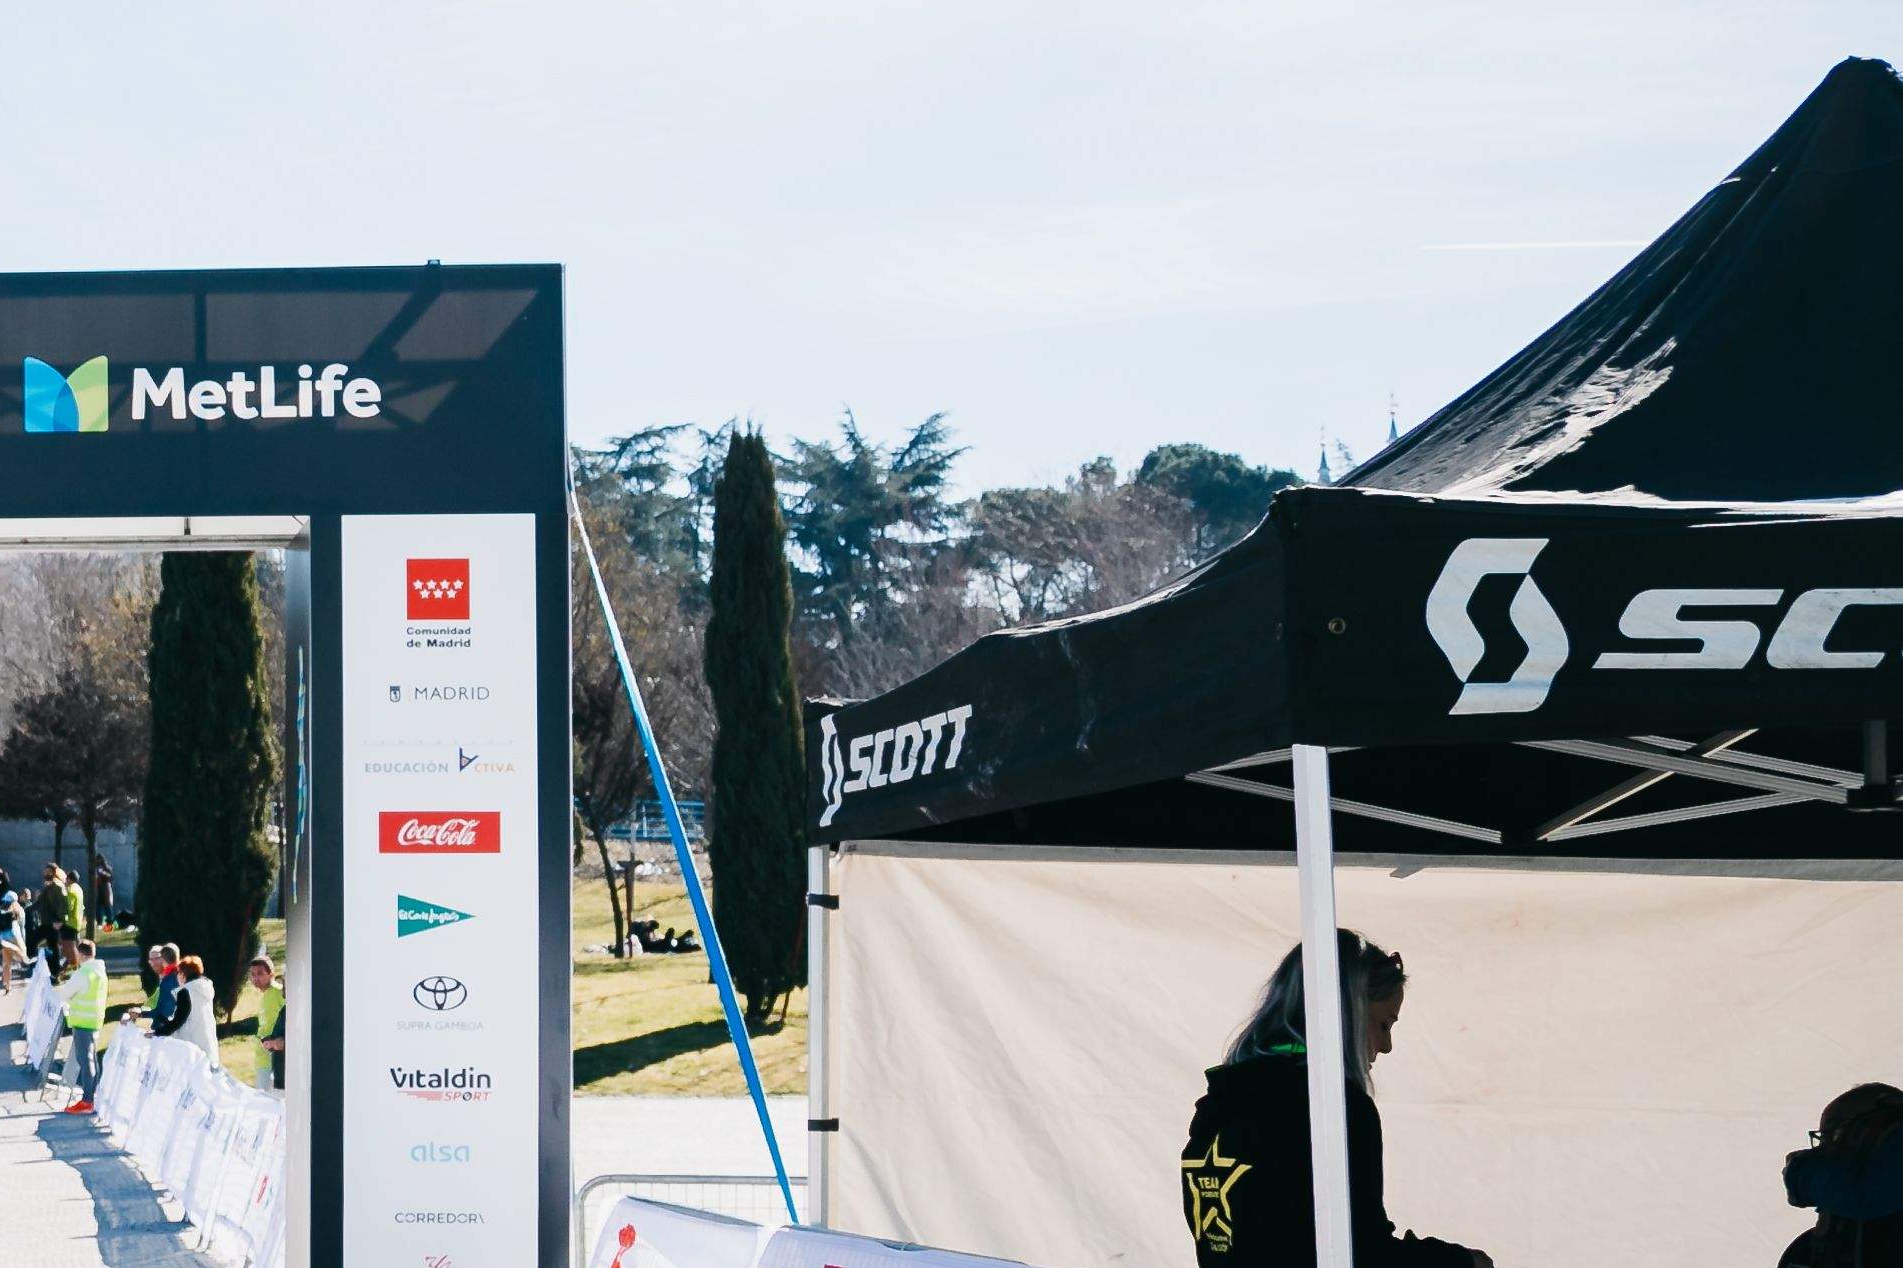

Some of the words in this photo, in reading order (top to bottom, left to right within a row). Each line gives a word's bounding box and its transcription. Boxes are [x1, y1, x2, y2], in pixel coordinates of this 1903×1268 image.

[131, 363, 382, 420] MetLife
[406, 627, 472, 636] Comunidad
[1591, 588, 1903, 669] SC
[406, 638, 421, 648] de
[427, 638, 472, 648] Madrid
[414, 686, 490, 700] MADRID
[843, 704, 973, 793] SCOTT
[397, 1021, 431, 1031] SUPRA
[435, 1021, 484, 1031] GAMBOA
[390, 1067, 491, 1088] Vitaldin
[444, 1091, 492, 1101] SPORT
[410, 1141, 470, 1163] alsa
